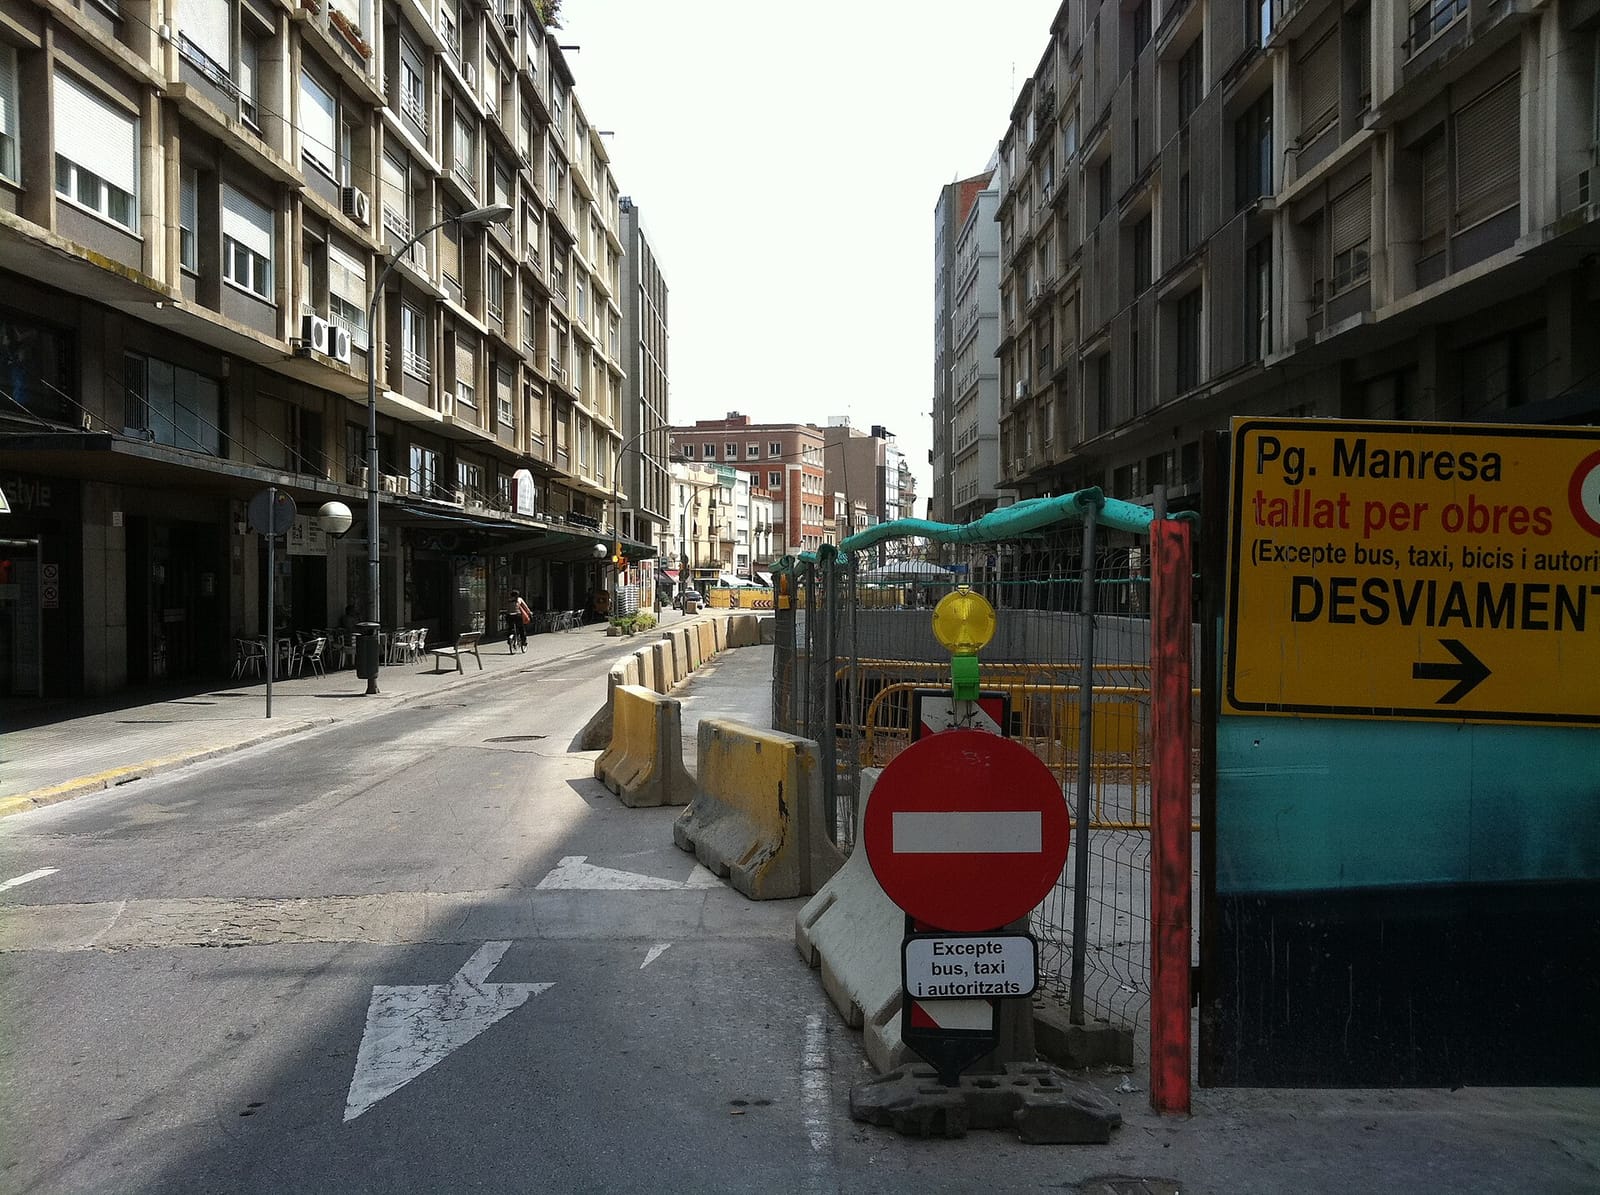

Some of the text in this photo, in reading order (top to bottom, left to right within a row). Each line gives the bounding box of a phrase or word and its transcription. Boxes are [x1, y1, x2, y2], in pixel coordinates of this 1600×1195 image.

[1257, 435, 1502, 486] Pg. Manresa
[1252, 489, 1553, 539] tallat per obres
[1251, 539, 1600, 572] (Excepte bus, taxi, bicis i autori
[933, 941, 1003, 958] Excepte
[931, 960, 1006, 977] bus, taxi
[917, 981, 1014, 996] i autoritzats
